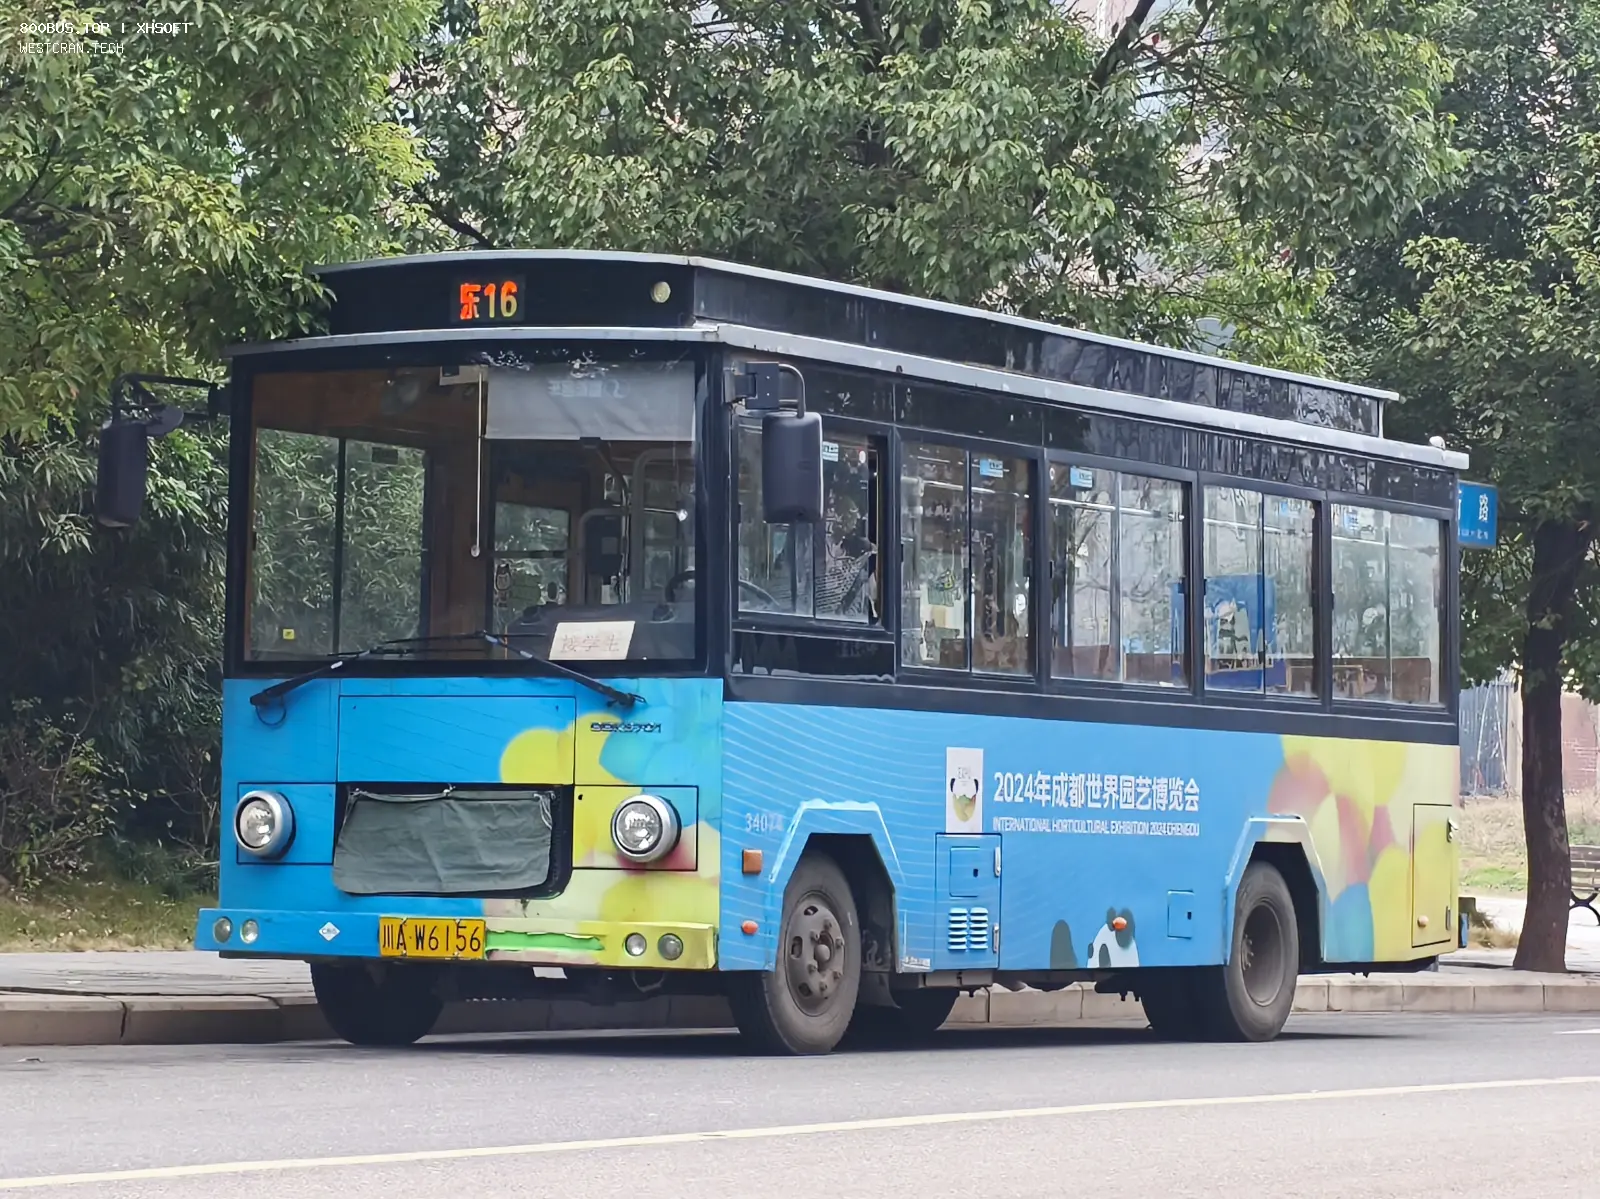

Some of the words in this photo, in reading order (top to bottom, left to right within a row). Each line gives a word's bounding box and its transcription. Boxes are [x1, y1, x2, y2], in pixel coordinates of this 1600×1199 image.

[994, 770, 1199, 811] 2024年成都世界园艺博览会
[992, 816, 1051, 833] INTERNATIONAL
[1052, 819, 1110, 834] HORTICULTURAL
[1110, 820, 1149, 835] EXHIBITION
